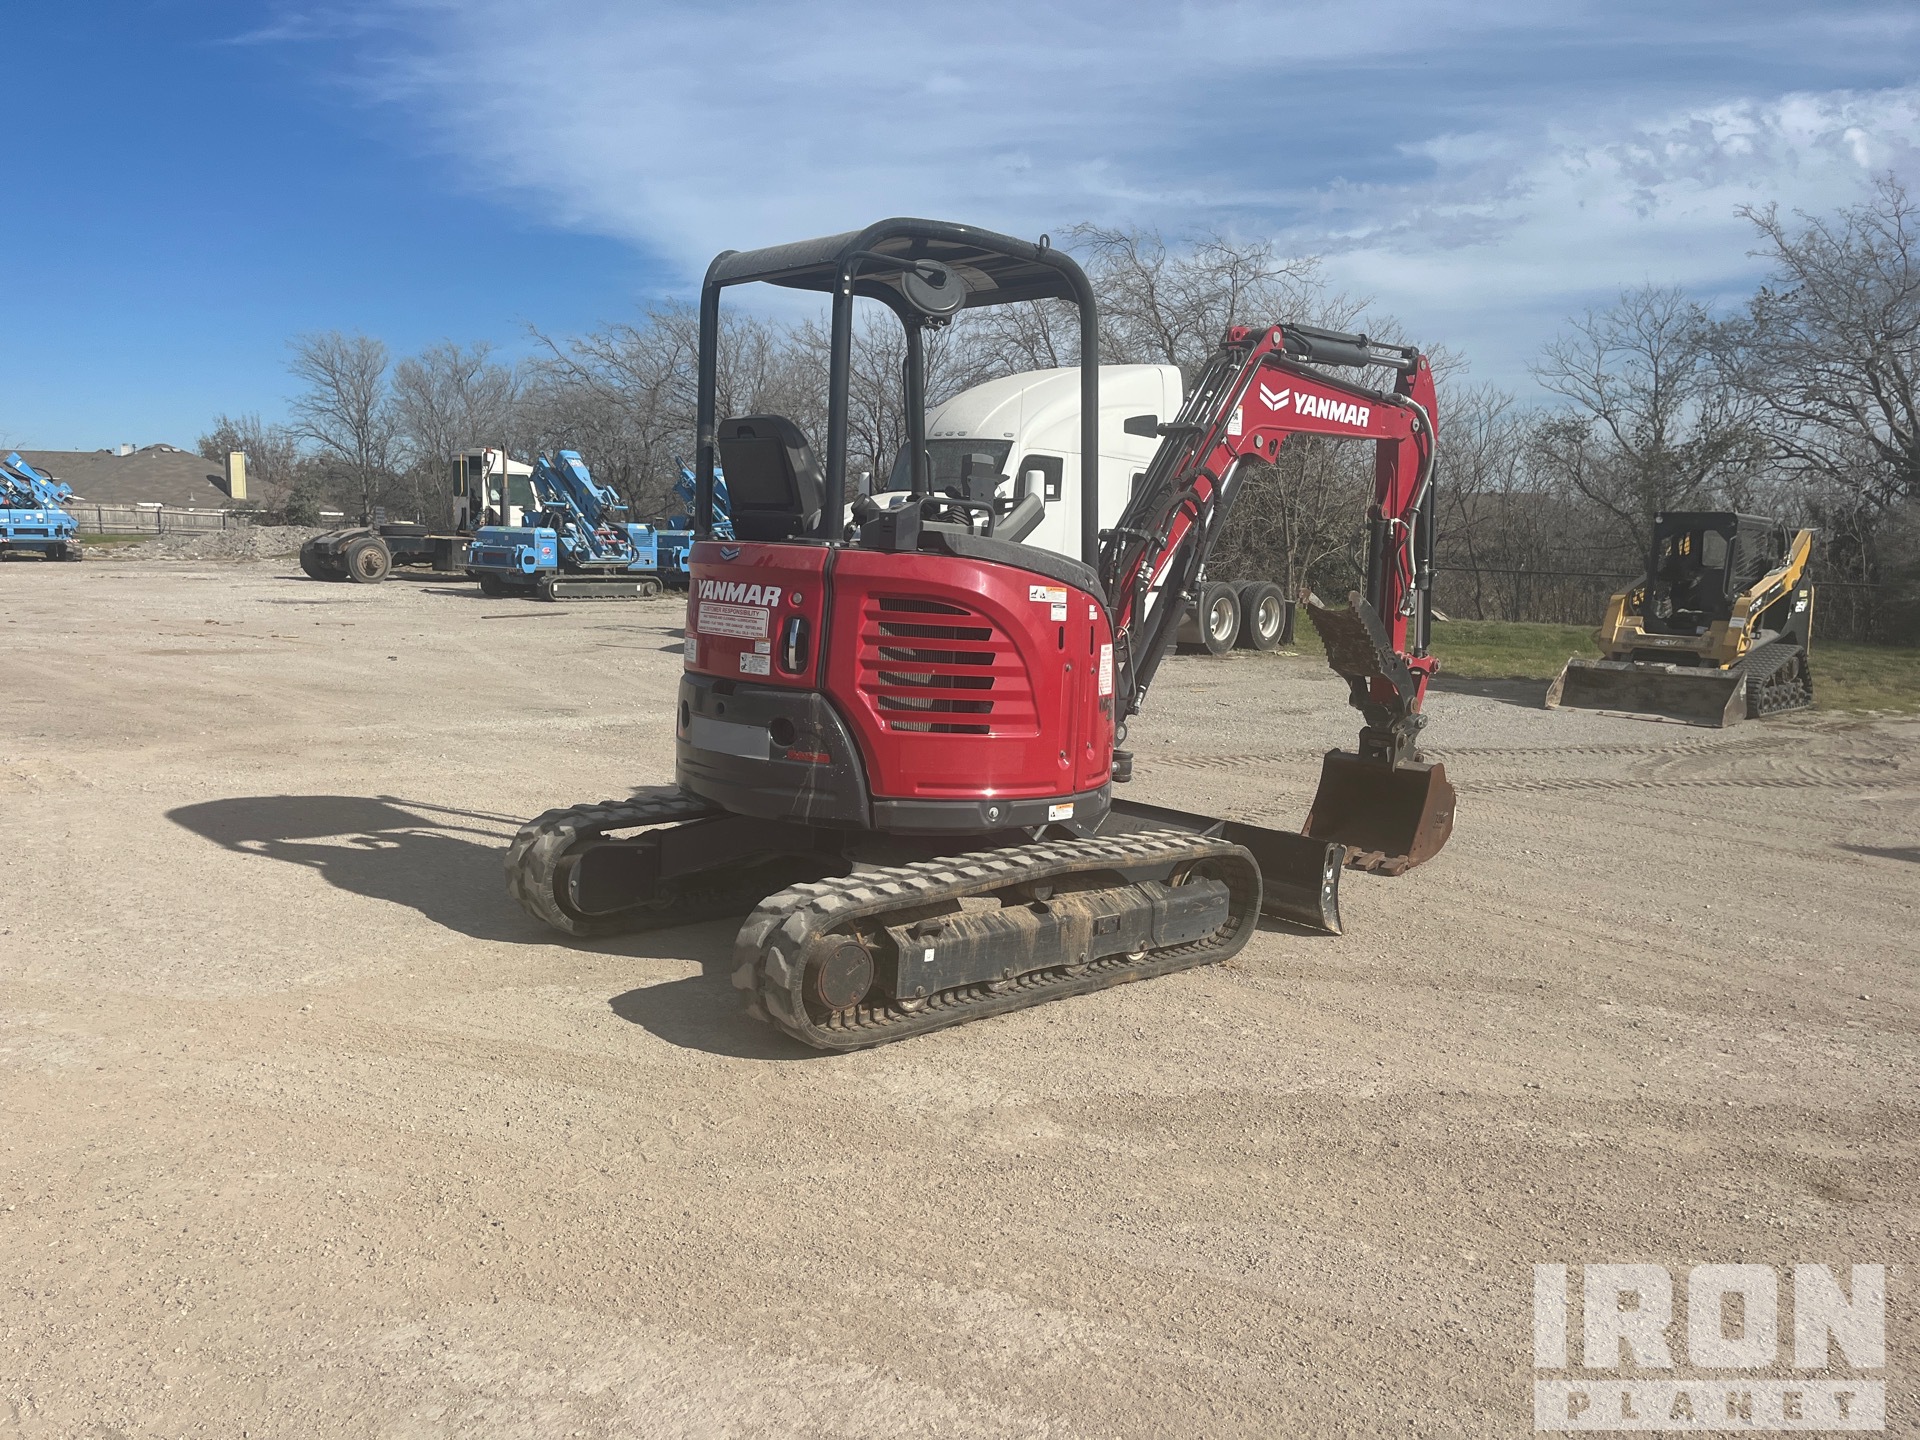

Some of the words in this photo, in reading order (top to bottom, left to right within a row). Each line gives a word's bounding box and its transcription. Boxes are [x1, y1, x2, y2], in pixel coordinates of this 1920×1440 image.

[1293, 391, 1370, 428] YANMAR
[697, 579, 782, 607] YANMAR
[722, 607, 760, 616] RESPONSIBILITY
